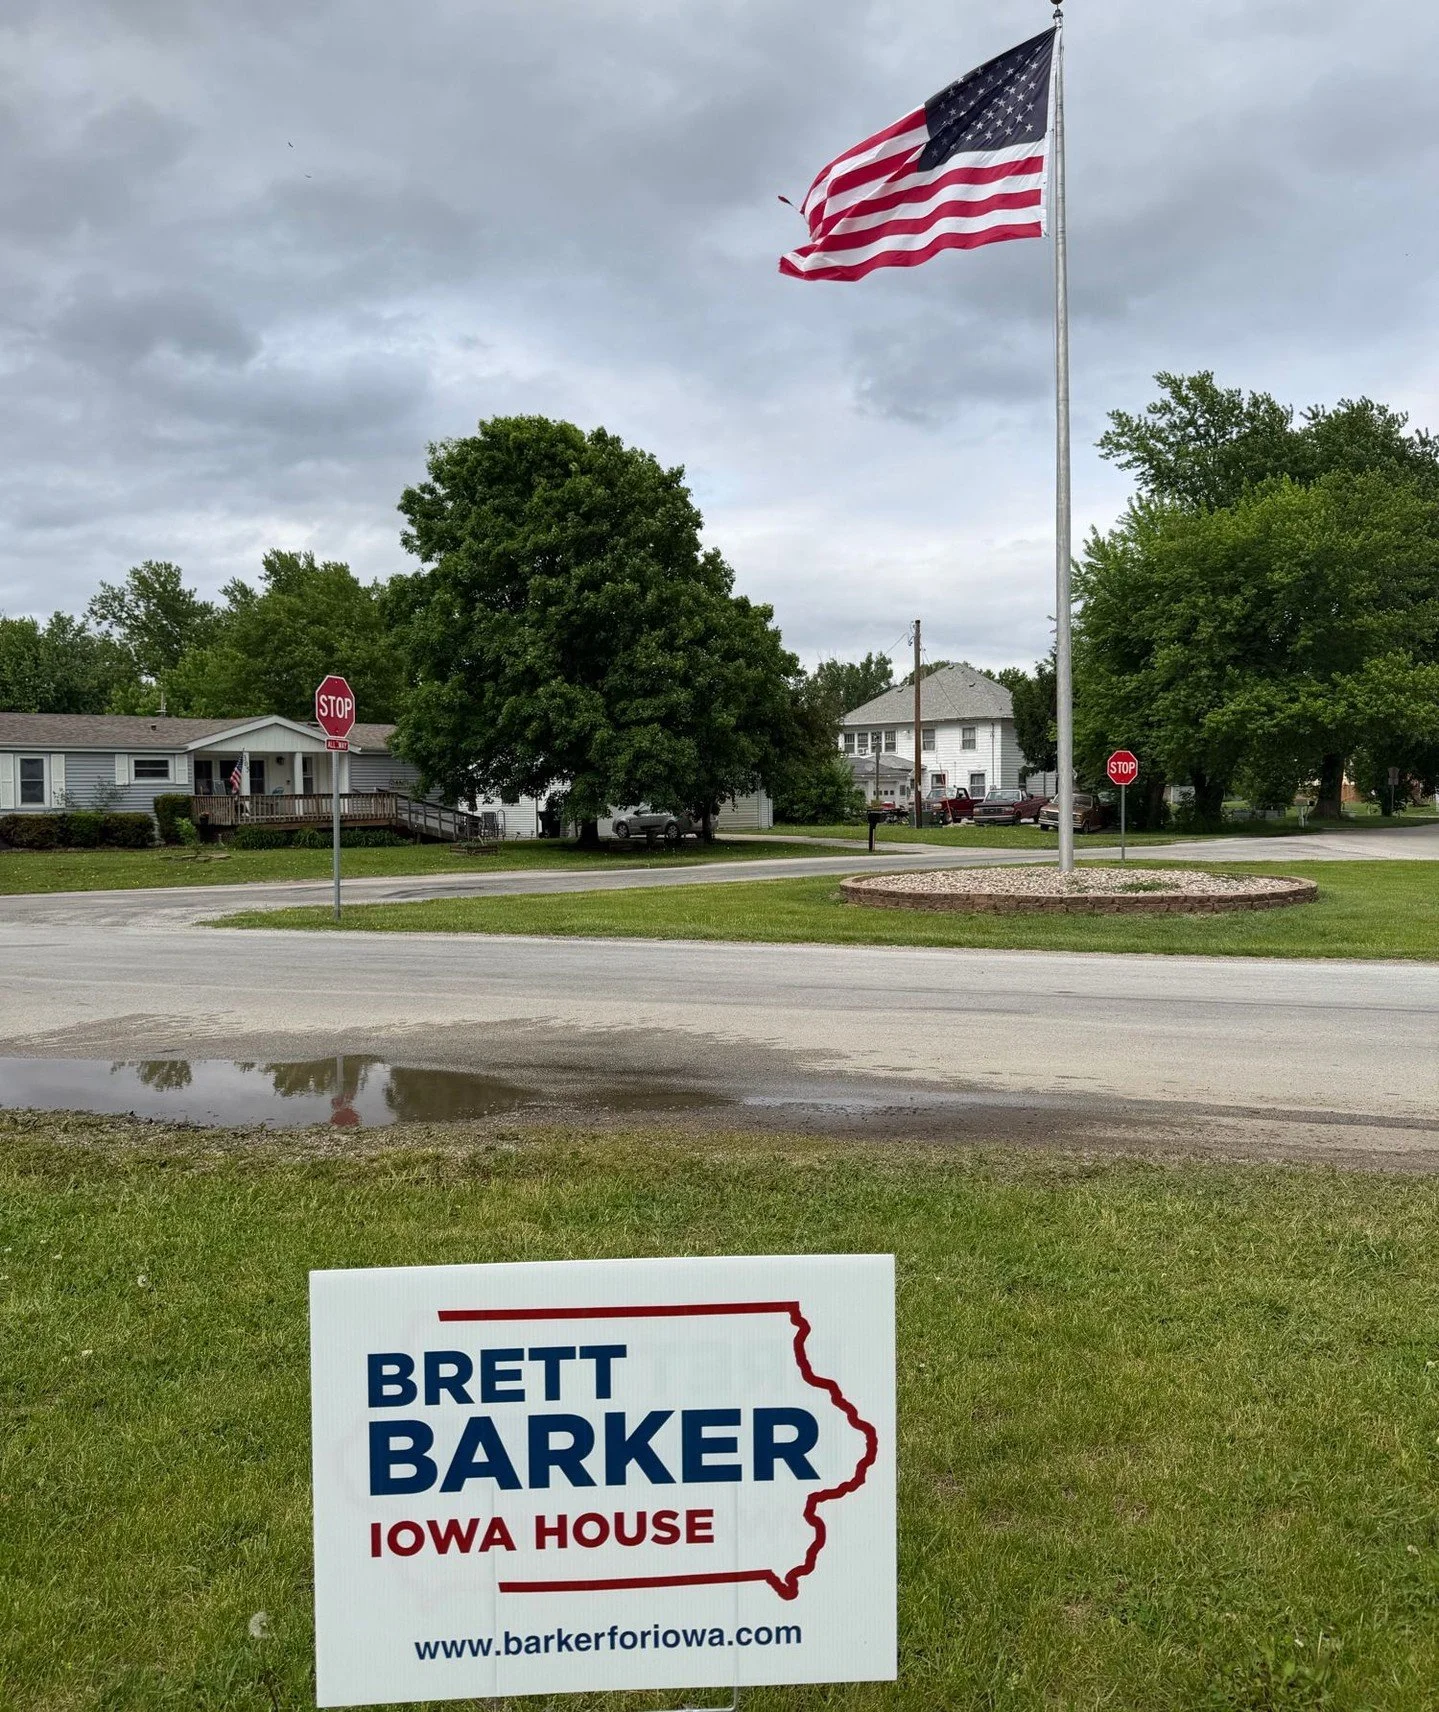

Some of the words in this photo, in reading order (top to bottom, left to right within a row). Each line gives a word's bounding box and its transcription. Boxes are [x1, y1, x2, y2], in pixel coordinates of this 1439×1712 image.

[319, 695, 352, 719] STOP
[1110, 761, 1136, 774] STOP
[367, 1345, 627, 1408] BRETT
[369, 1407, 820, 1496] BARKER
[371, 1517, 516, 1557] IOWA
[535, 1509, 715, 1550] HOUSE
[414, 1623, 802, 1661] www.barkerforiowa.com
